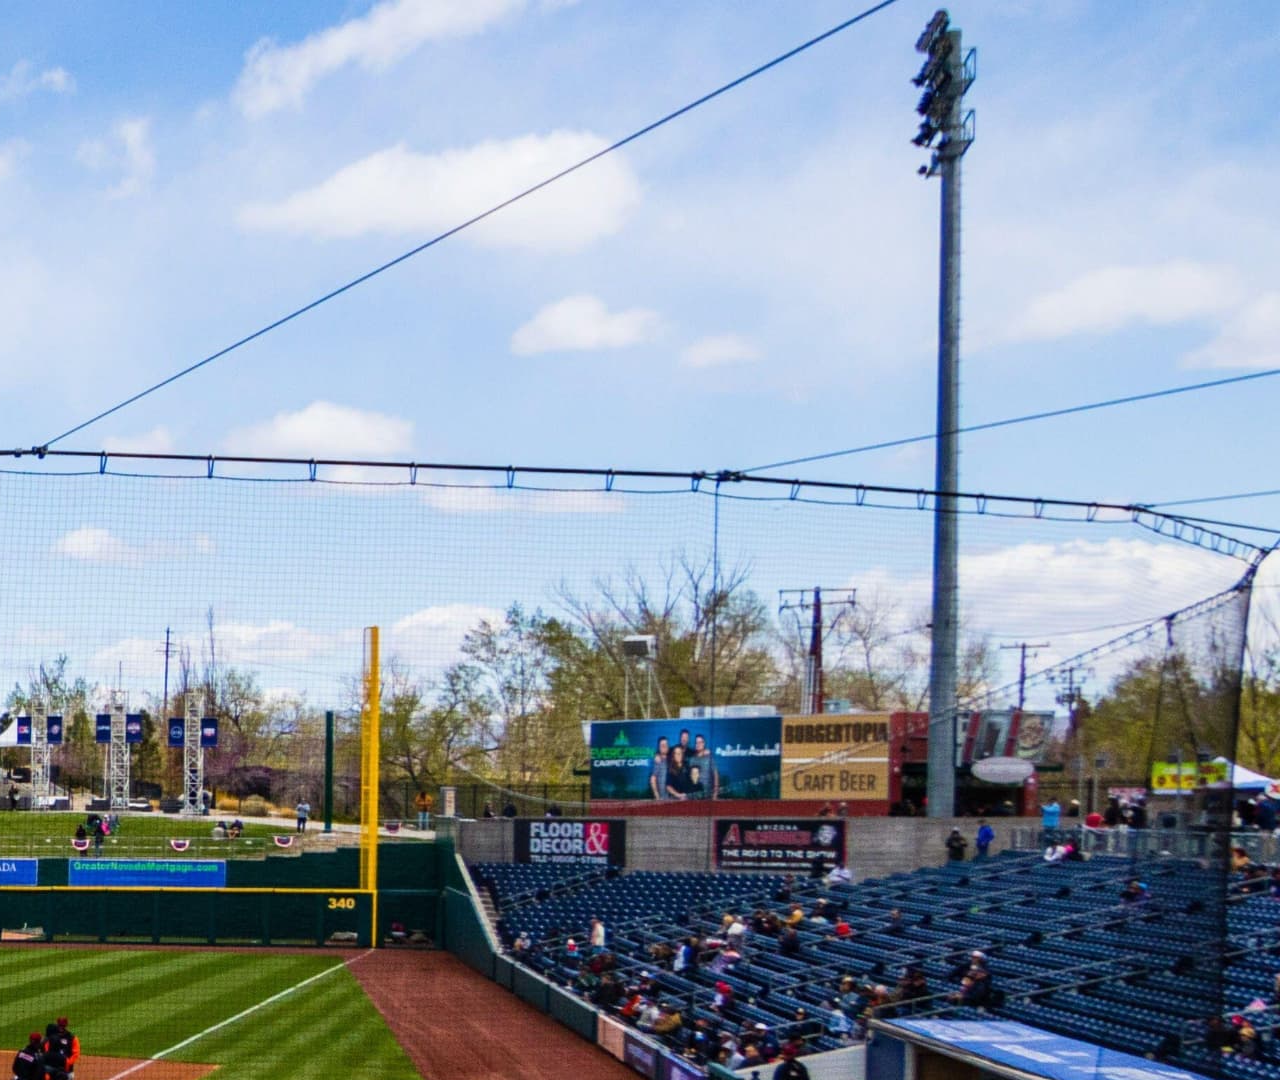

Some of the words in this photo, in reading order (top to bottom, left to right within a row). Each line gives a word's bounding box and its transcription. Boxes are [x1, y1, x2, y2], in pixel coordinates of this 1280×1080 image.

[784, 722, 888, 743] BURGERTOPIA
[593, 759, 625, 767] CARPET
[627, 759, 649, 767] CARE
[530, 822, 583, 837] FLOOR
[530, 838, 583, 854] DECOR
[722, 849, 739, 857] THE
[328, 898, 355, 909] 340
